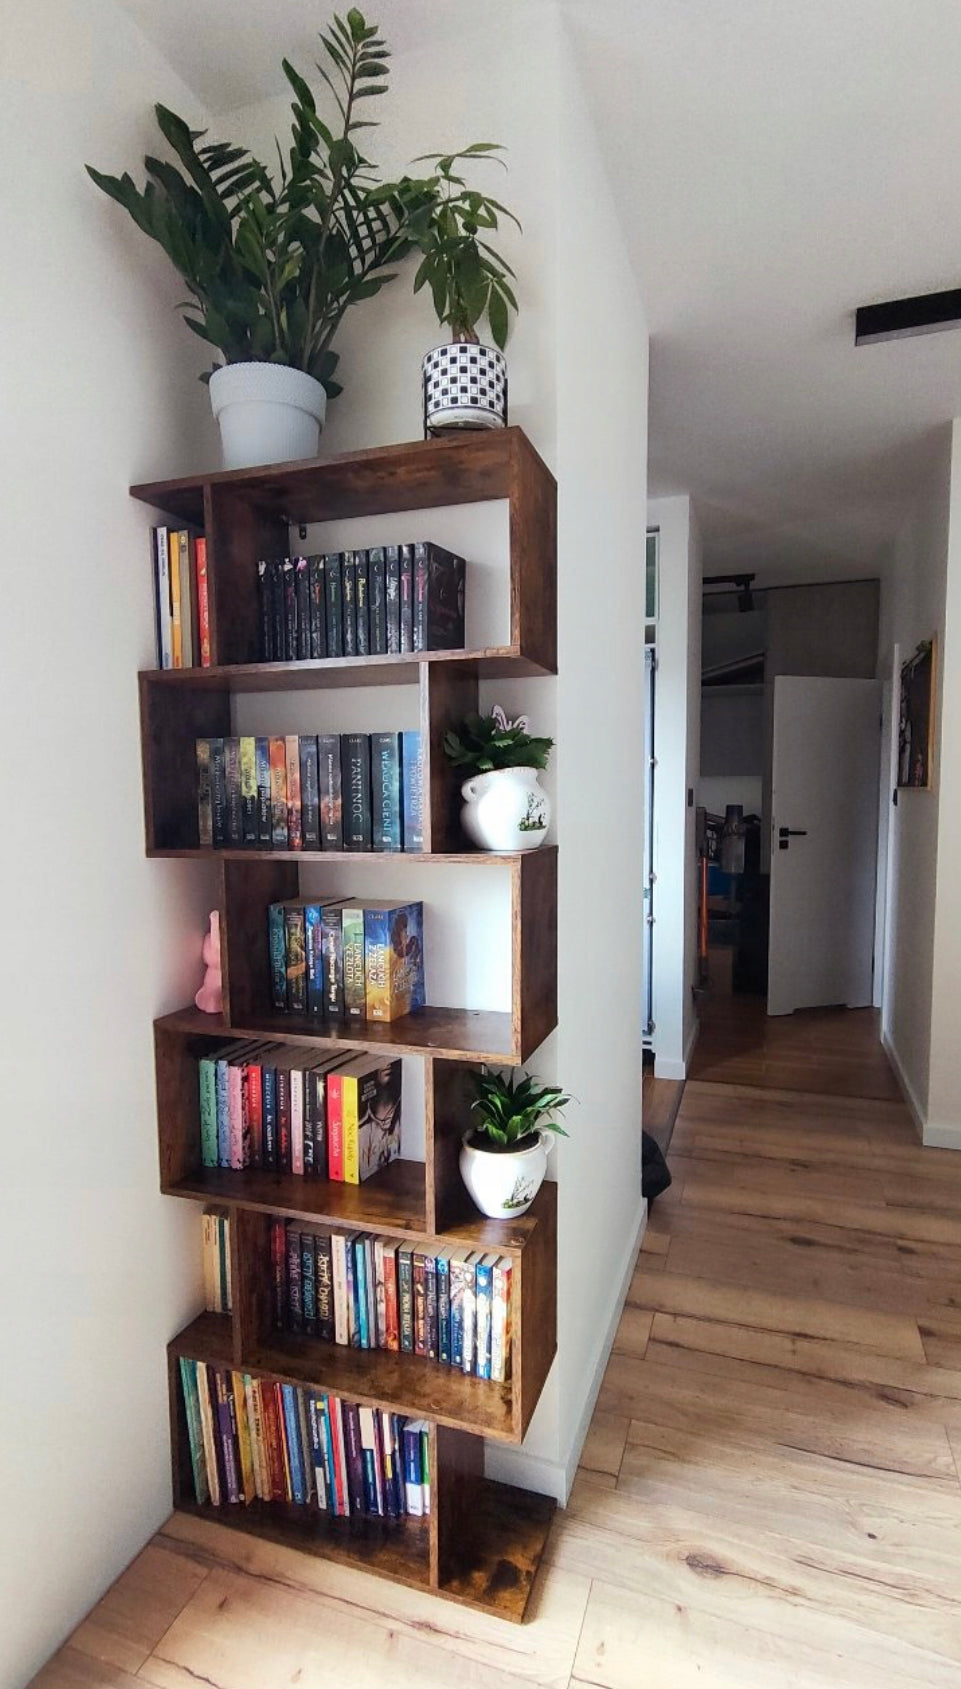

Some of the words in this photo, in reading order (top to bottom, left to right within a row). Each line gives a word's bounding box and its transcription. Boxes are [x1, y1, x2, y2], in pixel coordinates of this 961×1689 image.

[351, 758, 362, 790] PANI
[352, 792, 363, 823] NOC
[382, 800, 392, 831] CIENI
[330, 984, 338, 1002] Targu
[332, 1120, 340, 1157] Szeptucha
